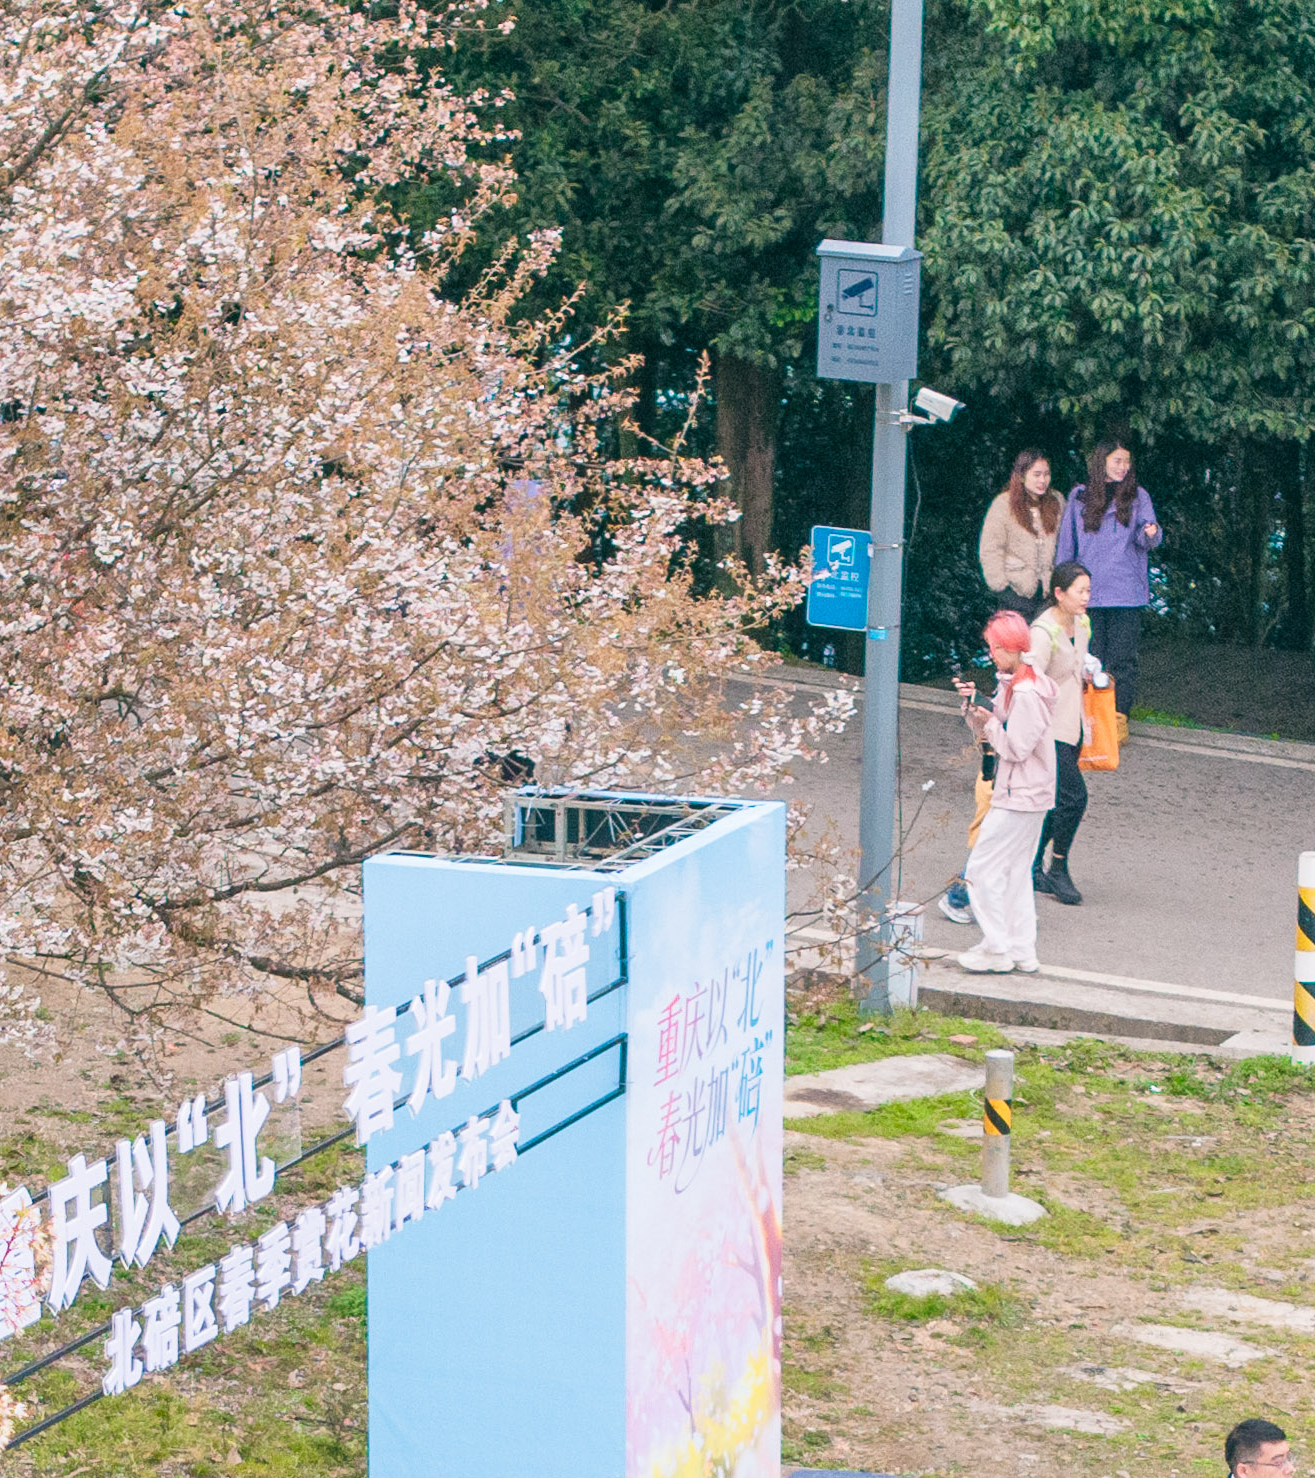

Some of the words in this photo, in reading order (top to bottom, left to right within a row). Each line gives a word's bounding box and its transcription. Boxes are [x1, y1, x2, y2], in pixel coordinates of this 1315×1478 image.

[343, 886, 617, 1148] 春光加“碚”
[647, 1029, 773, 1195] 春光加“碚”
[653, 938, 774, 1087] 重庆以“北”
[102, 1098, 522, 1397] 北碚区春季赏花新闻发布会
